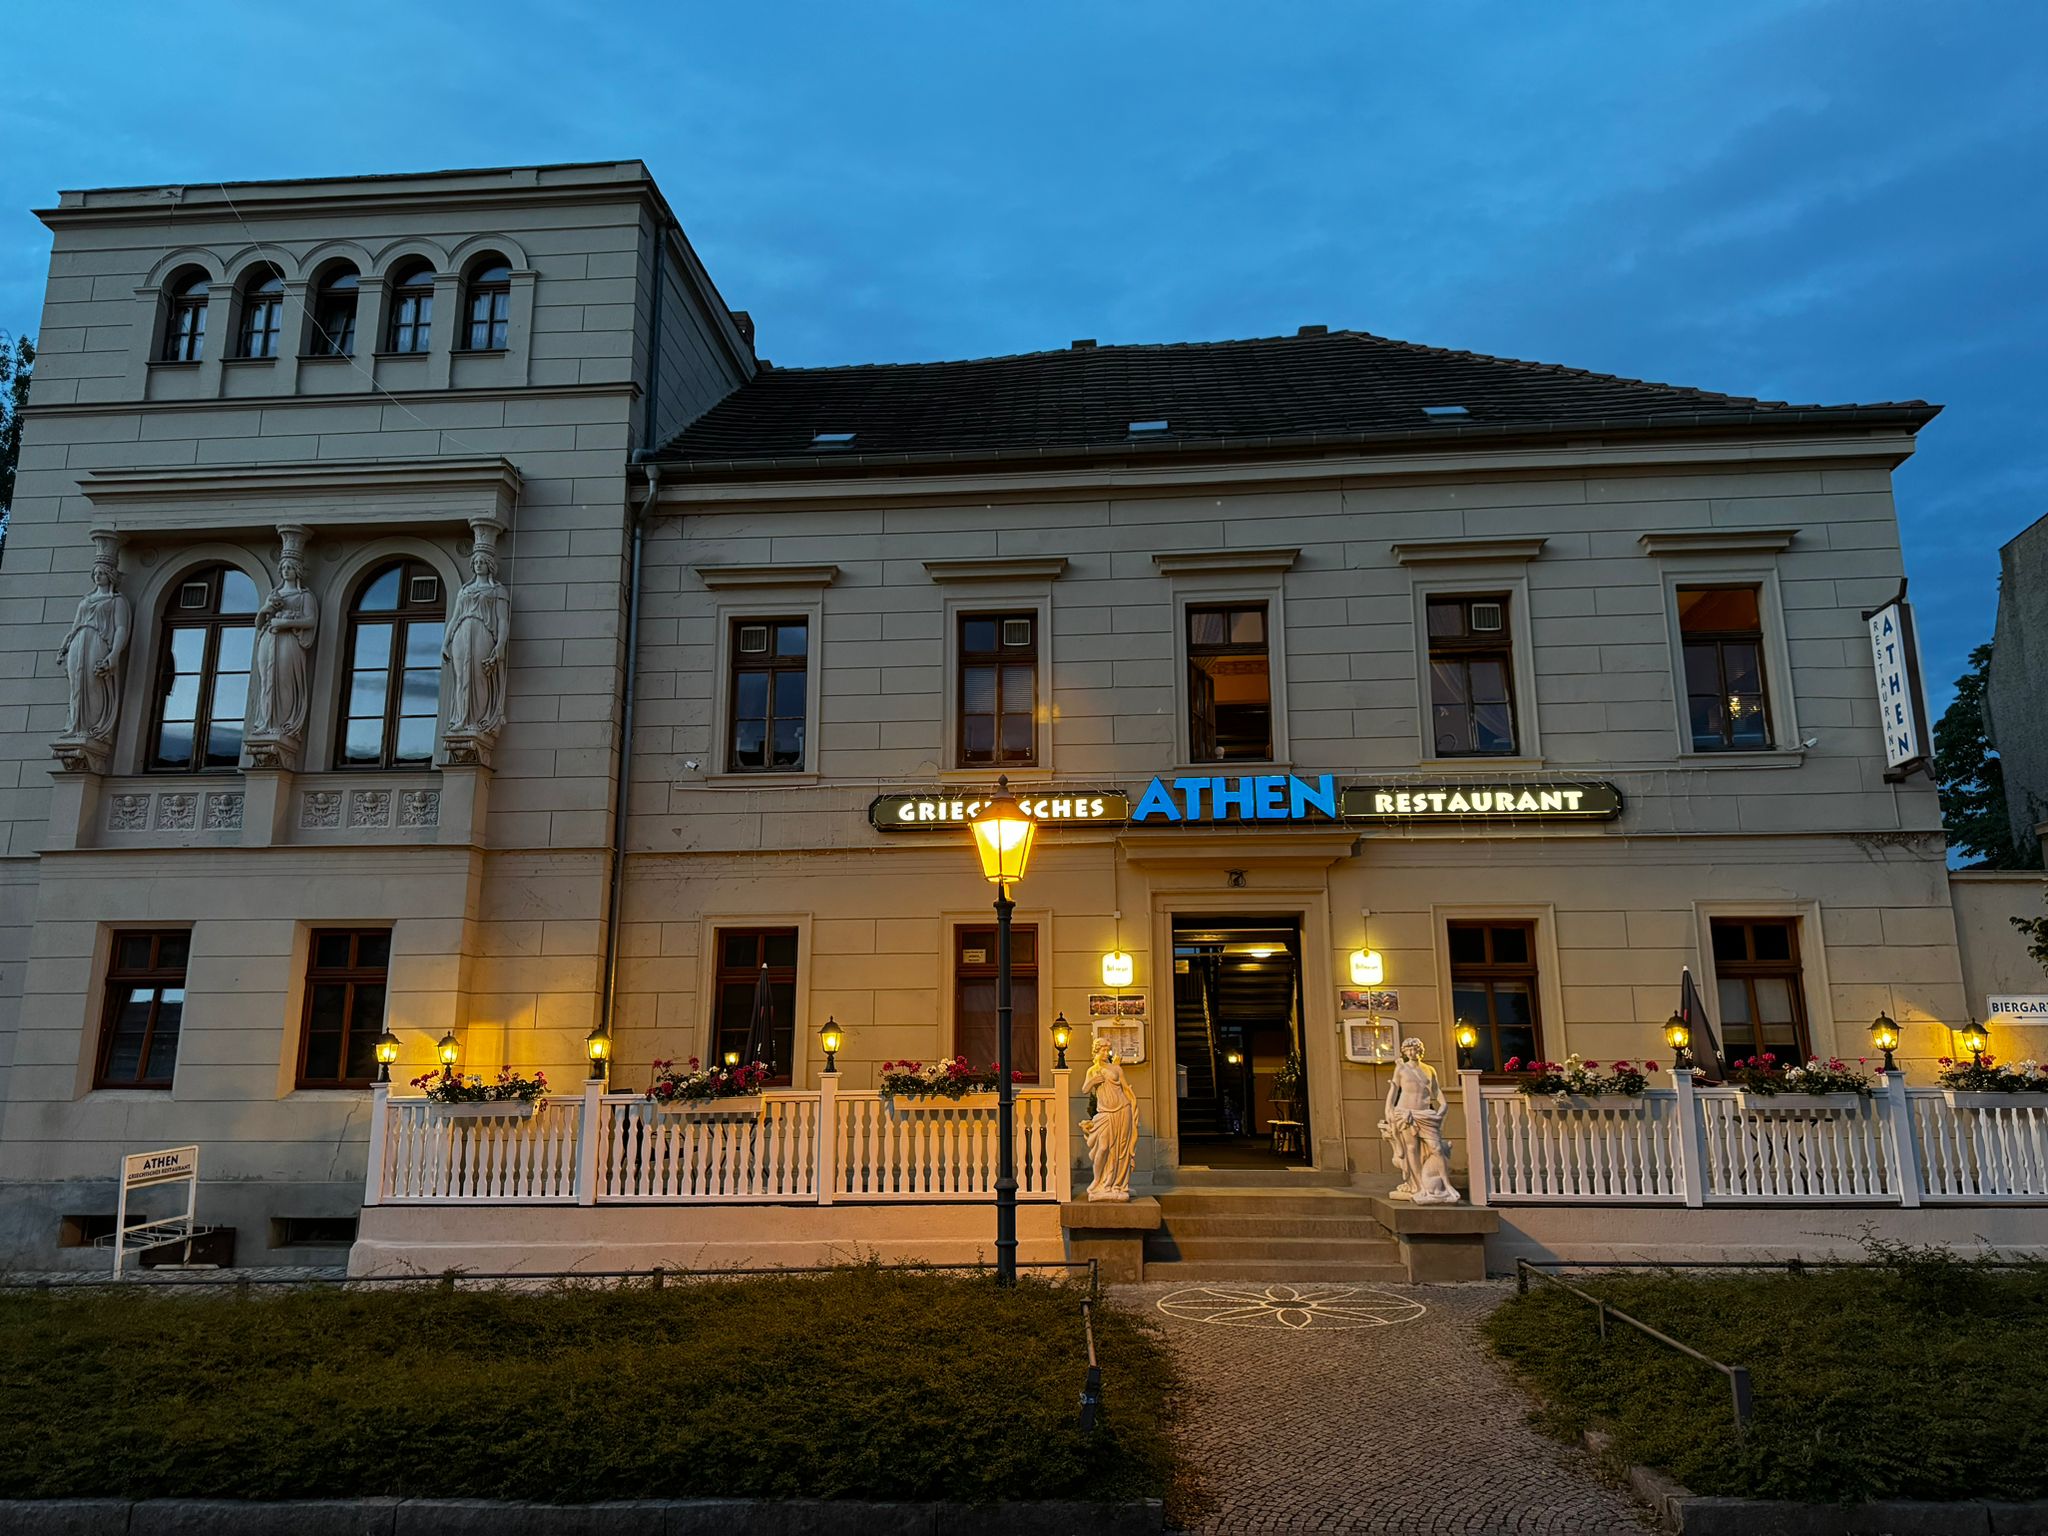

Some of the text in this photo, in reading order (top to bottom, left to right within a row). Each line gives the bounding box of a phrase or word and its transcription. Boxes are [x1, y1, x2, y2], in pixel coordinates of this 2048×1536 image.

[1873, 621, 1896, 760] RESTAURANT
[1882, 615, 1909, 756] ATHEN
[1131, 773, 1336, 821] ATHEN
[1375, 791, 1583, 812] RESTAURANT
[899, 799, 1104, 821] GRIECSCHES
[1992, 1002, 2048, 1013] BIERGAR
[143, 1155, 179, 1169] ATHEN
[161, 1164, 190, 1173] RESTAURANT
